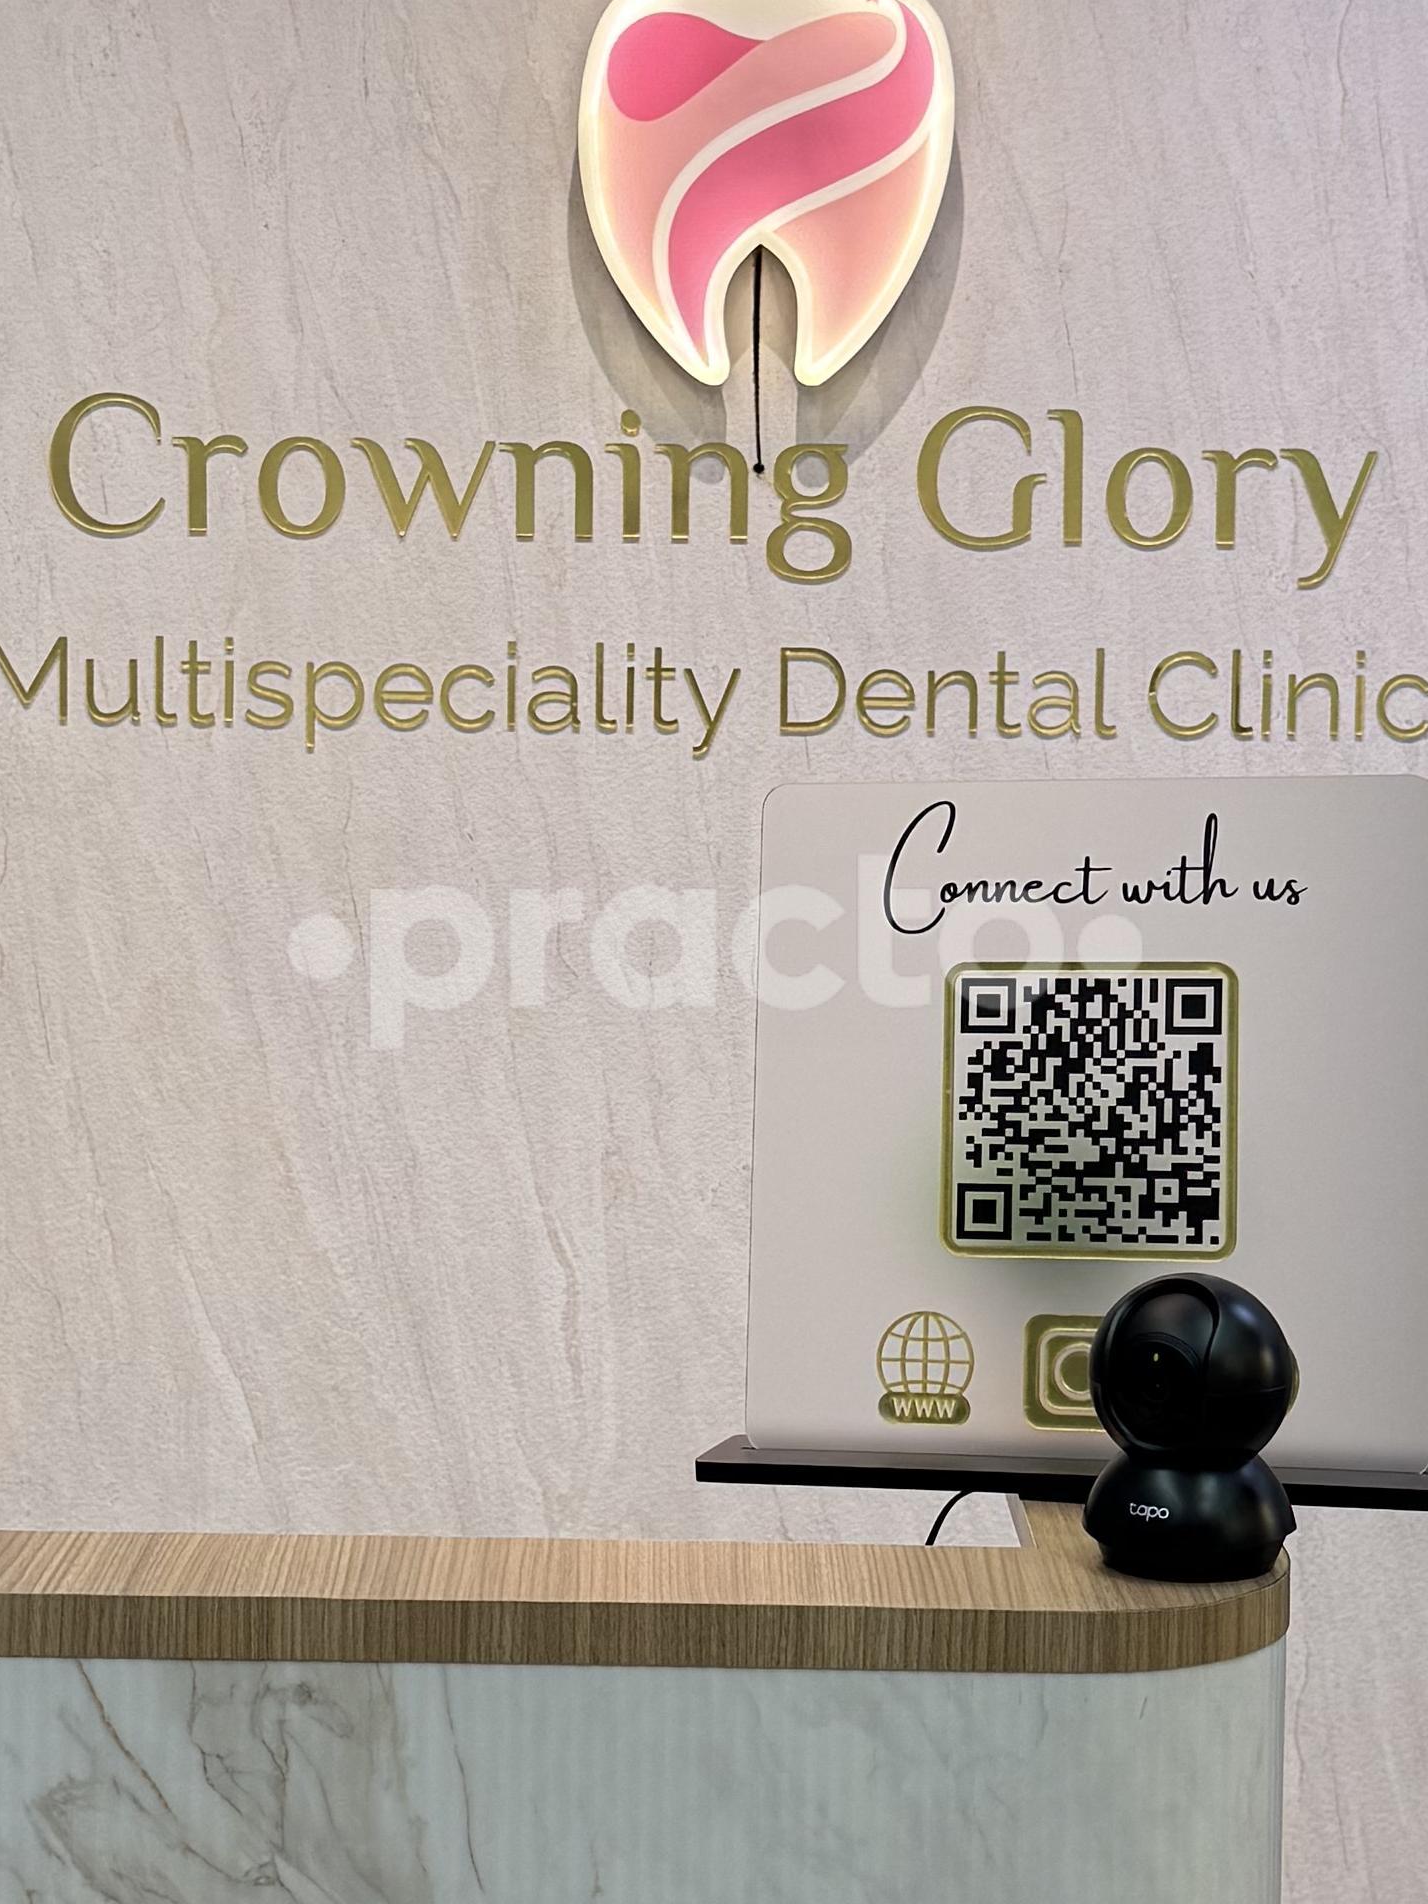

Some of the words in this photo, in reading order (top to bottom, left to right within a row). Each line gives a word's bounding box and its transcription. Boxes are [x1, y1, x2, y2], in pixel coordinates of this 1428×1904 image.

[49, 392, 853, 585] Crowning
[916, 405, 1379, 590] Glory
[779, 646, 1117, 739] Dental
[883, 800, 1112, 935] Connect
[1122, 812, 1239, 905] with
[1253, 874, 1309, 906] us
[1129, 1502, 1170, 1522] tapo
